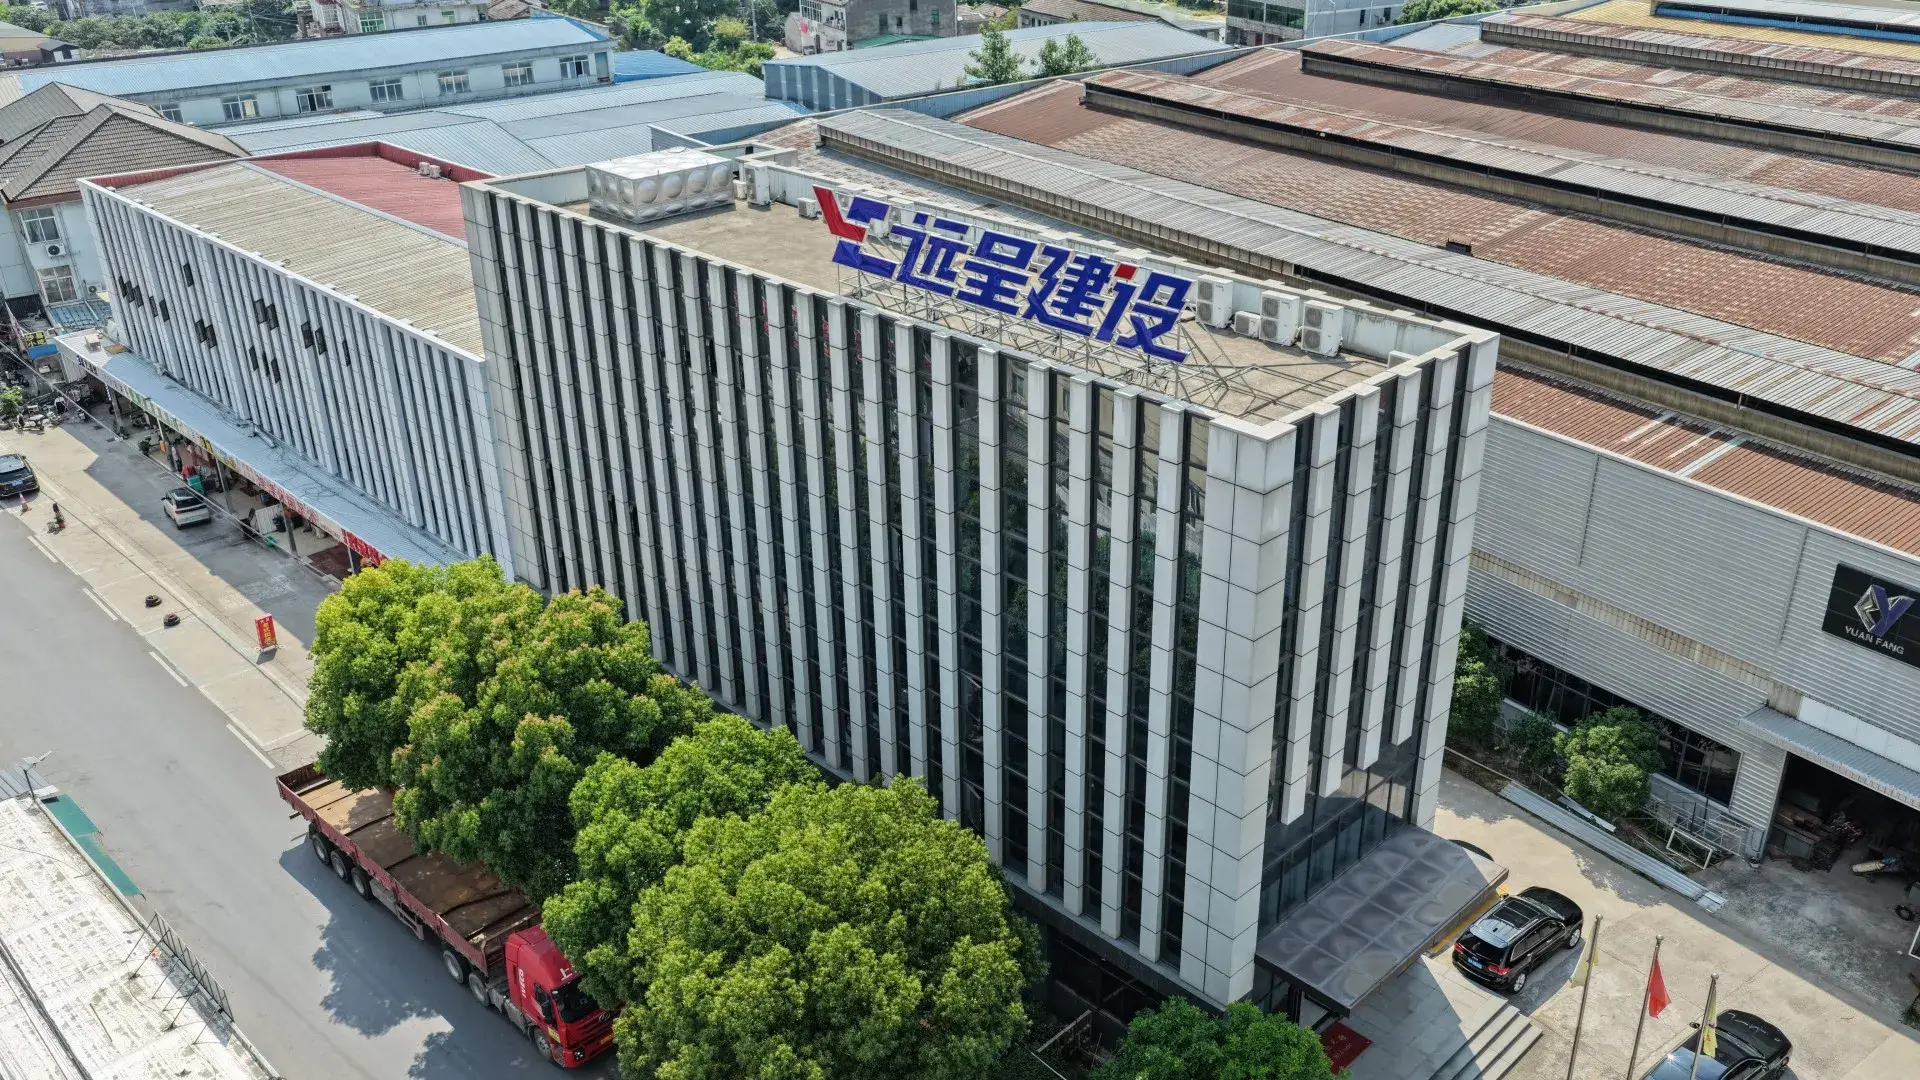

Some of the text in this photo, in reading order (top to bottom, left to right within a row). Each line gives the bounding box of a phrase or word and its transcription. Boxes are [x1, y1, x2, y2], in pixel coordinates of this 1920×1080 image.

[890, 211, 1196, 363] 远呈建设
[1844, 625, 1905, 655] YUAN FANG
